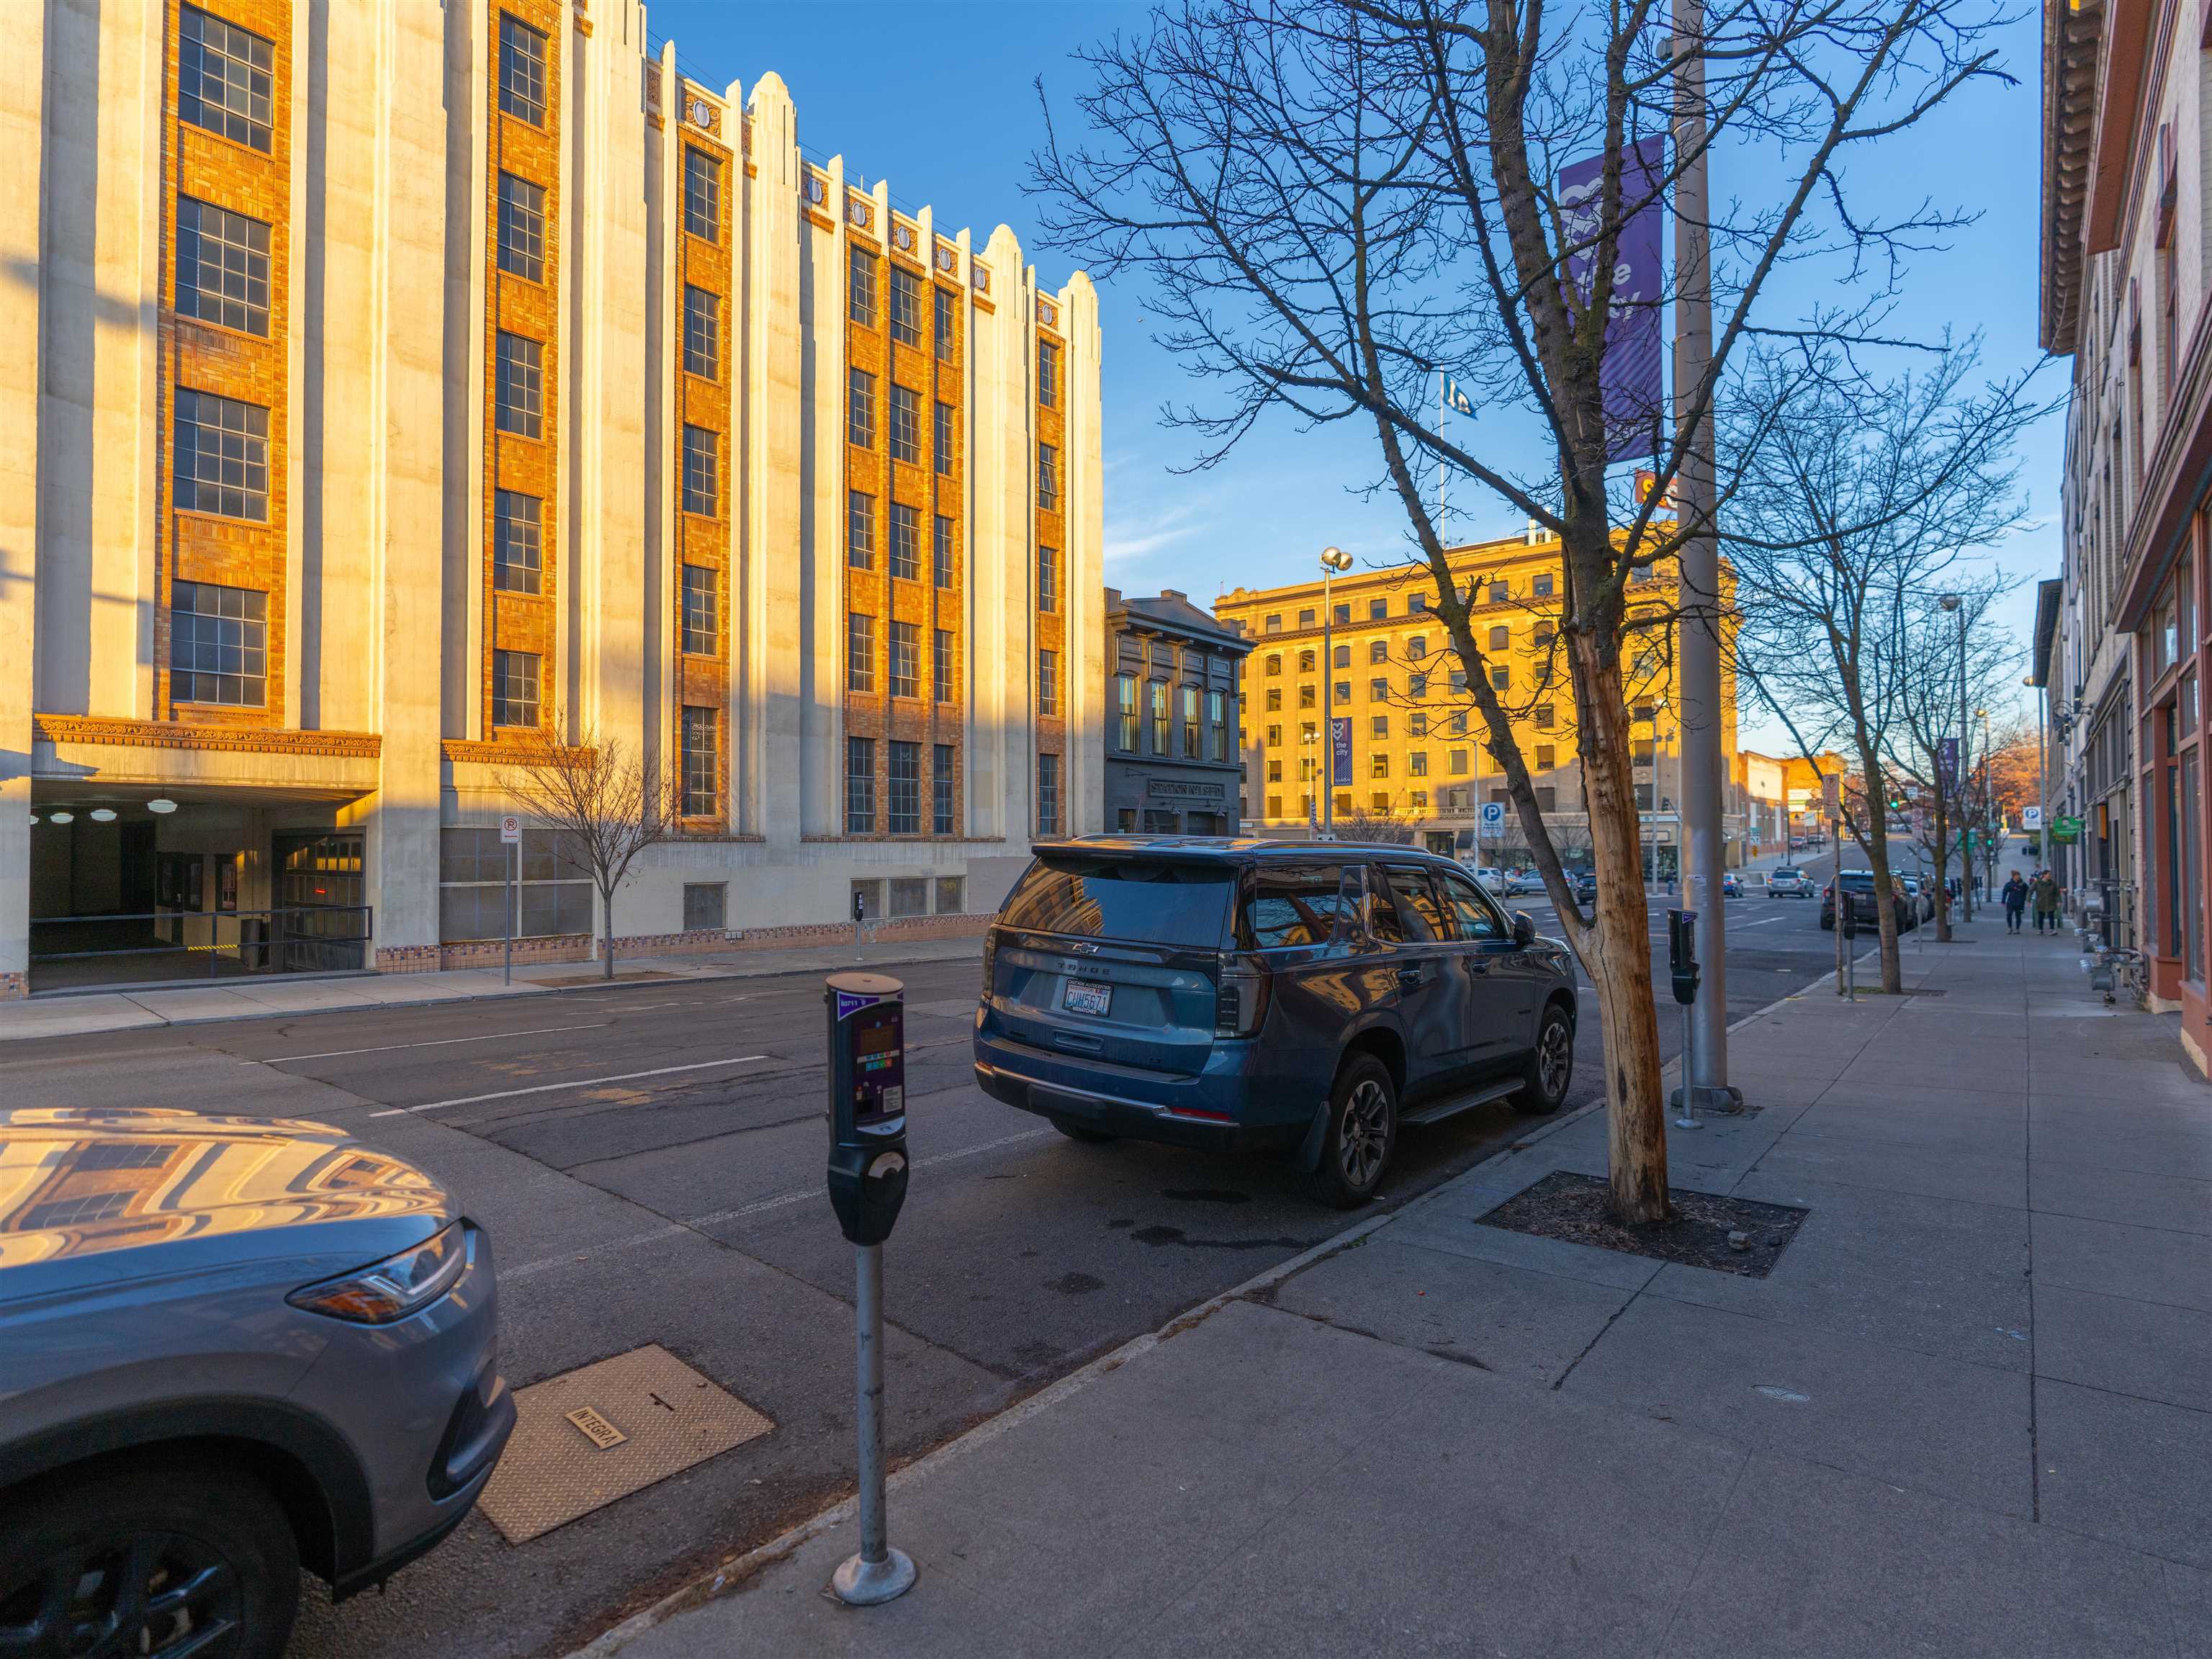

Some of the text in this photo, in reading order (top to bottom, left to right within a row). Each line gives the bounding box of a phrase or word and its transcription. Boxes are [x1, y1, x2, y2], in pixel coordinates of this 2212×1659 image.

[1577, 264, 1632, 295] te
[1058, 961, 1112, 975] TAHOE
[1067, 991, 1106, 1011] CUH5671
[572, 1409, 617, 1444] INTEGRA
